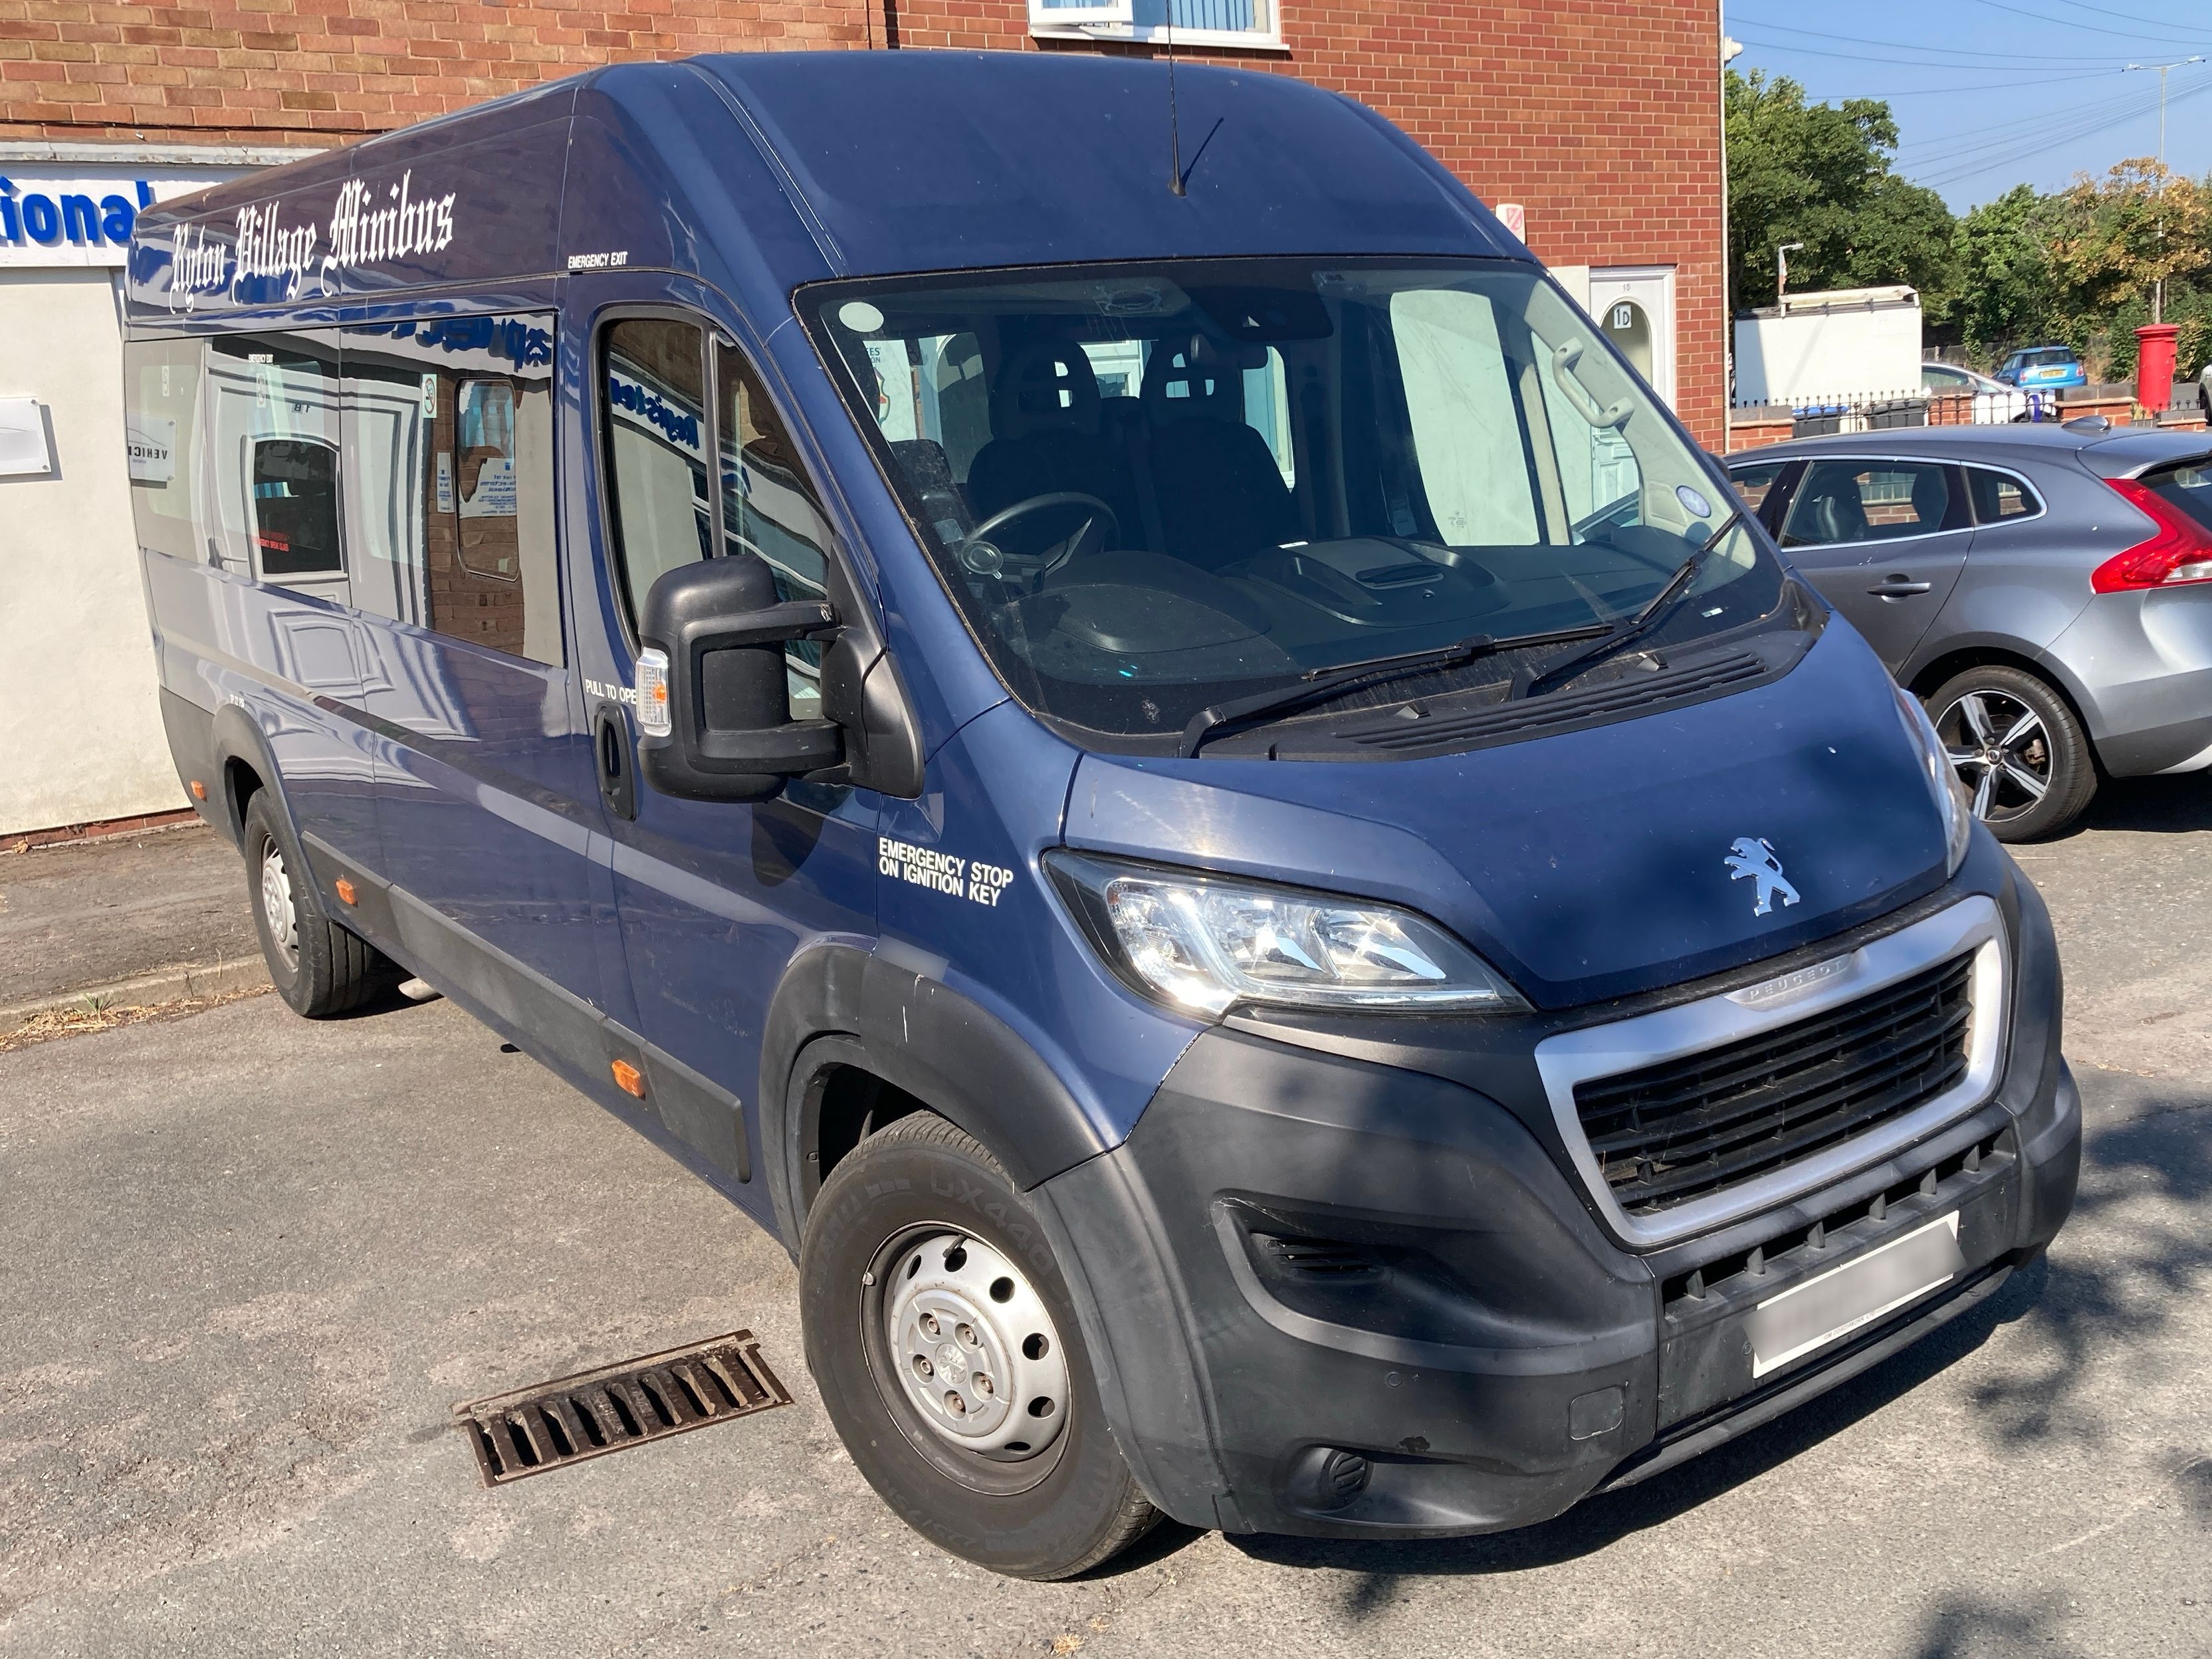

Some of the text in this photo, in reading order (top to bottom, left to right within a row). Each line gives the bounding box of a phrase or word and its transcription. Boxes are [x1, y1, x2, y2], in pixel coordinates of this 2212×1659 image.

[169, 168, 456, 314] Ryton Village Minibus
[568, 251, 628, 269] EMERGENCY EXIT
[1616, 308, 1630, 326] 1D
[585, 679, 604, 697] PULL
[606, 683, 617, 700] TO
[879, 836, 1014, 888] EMERGENCY STOP
[879, 855, 1002, 907] ON IGNITION KEY
[1749, 960, 1842, 999] PEUGEOT
